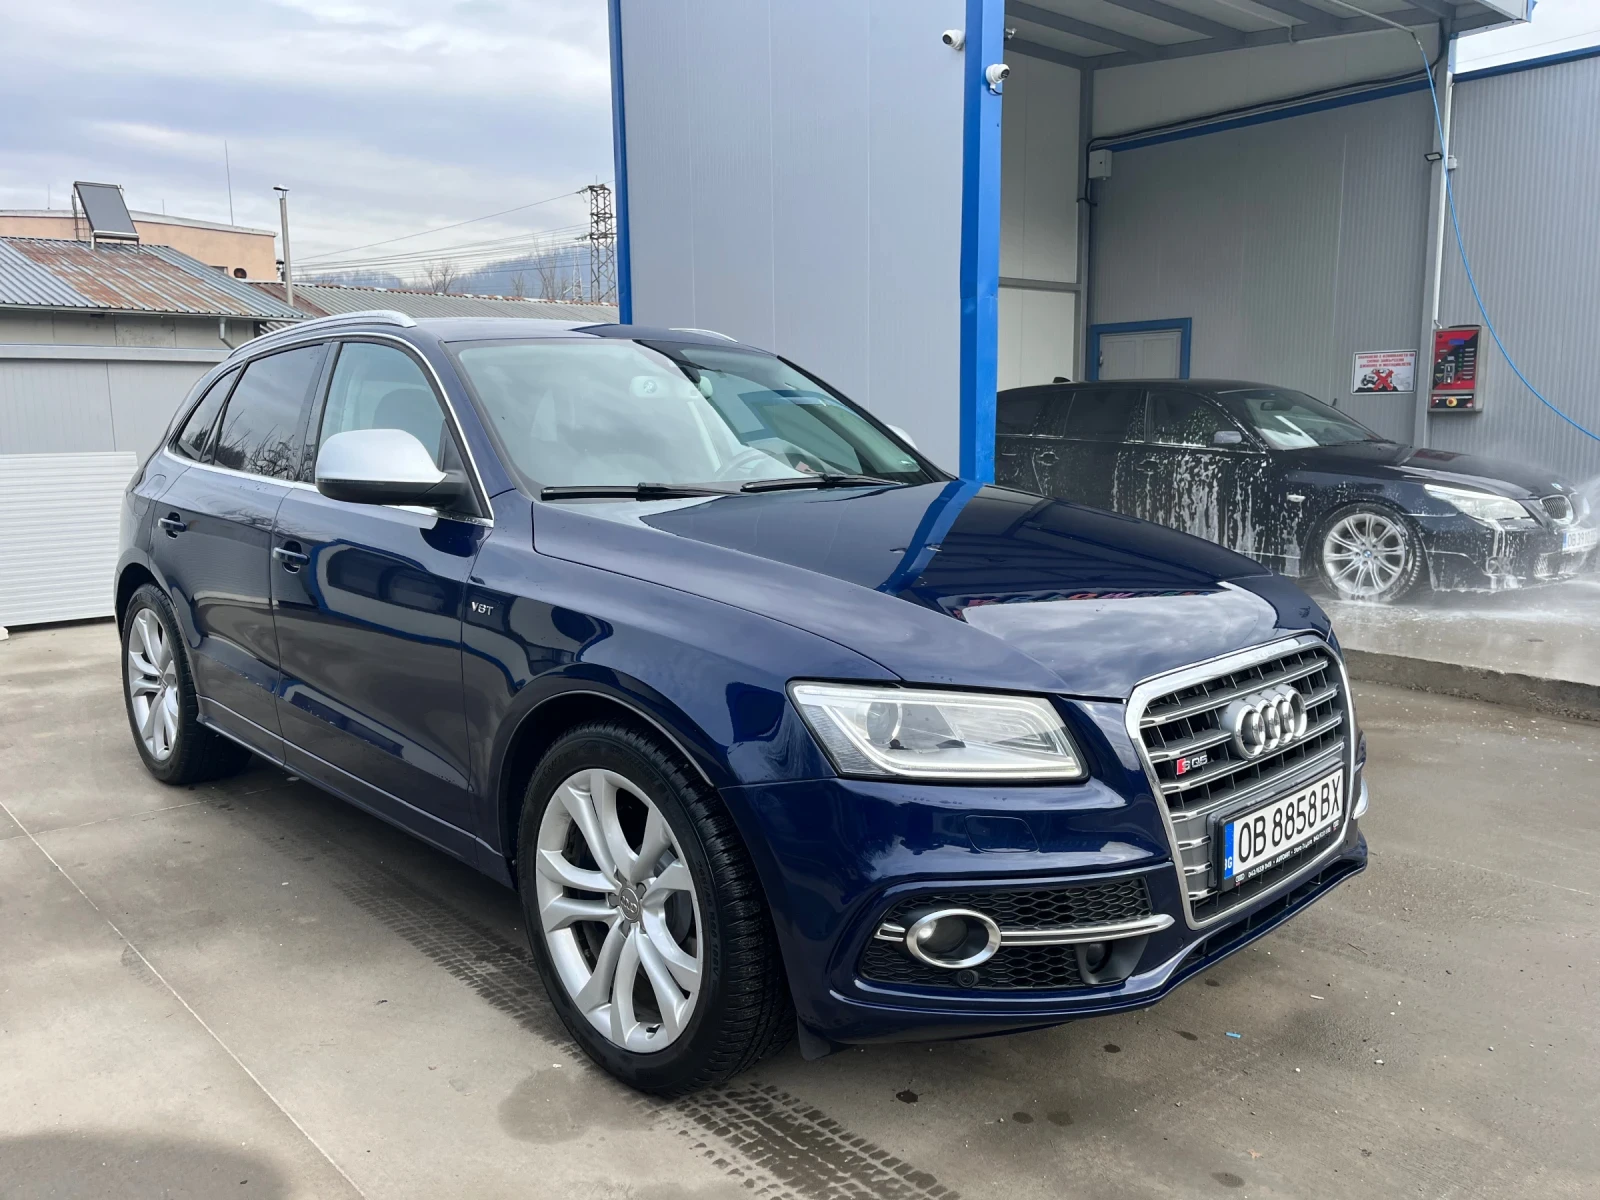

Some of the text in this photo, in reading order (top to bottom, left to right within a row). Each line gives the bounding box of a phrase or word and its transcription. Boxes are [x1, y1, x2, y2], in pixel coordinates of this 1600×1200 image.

[1238, 816, 1267, 863] OB
[1271, 789, 1317, 848] 8858
[1320, 775, 1341, 822] BX
